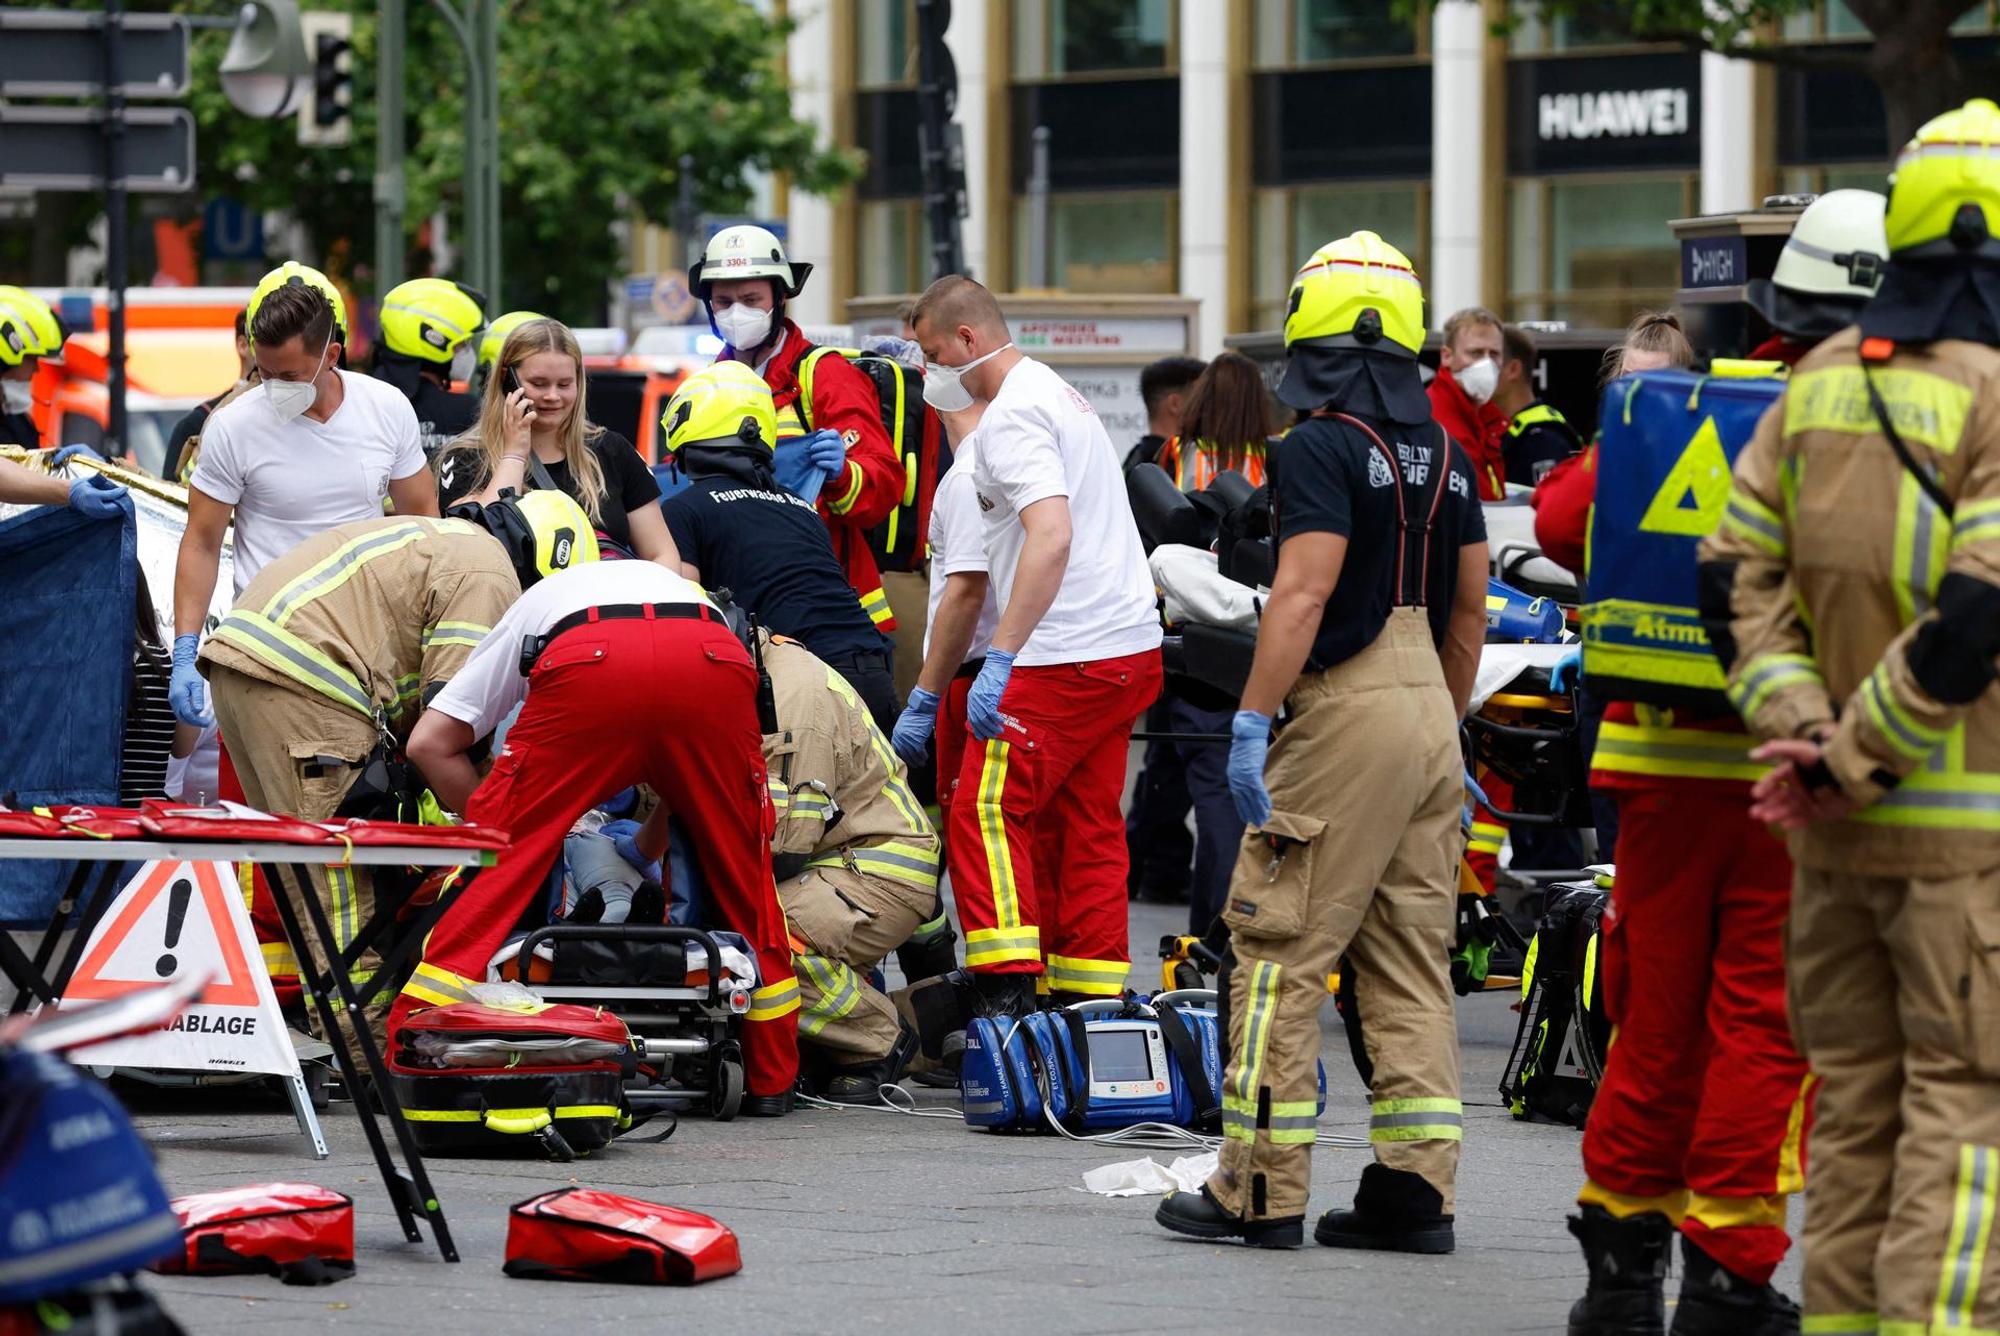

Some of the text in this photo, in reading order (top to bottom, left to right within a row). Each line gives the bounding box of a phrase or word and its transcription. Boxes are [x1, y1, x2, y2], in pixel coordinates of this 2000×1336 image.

[1539, 88, 1688, 139] HUAWEI
[216, 205, 253, 252] U
[726, 258, 748, 268] 3304
[161, 1014, 257, 1036] ABLAGE
[967, 1038, 981, 1049] ZOLL
